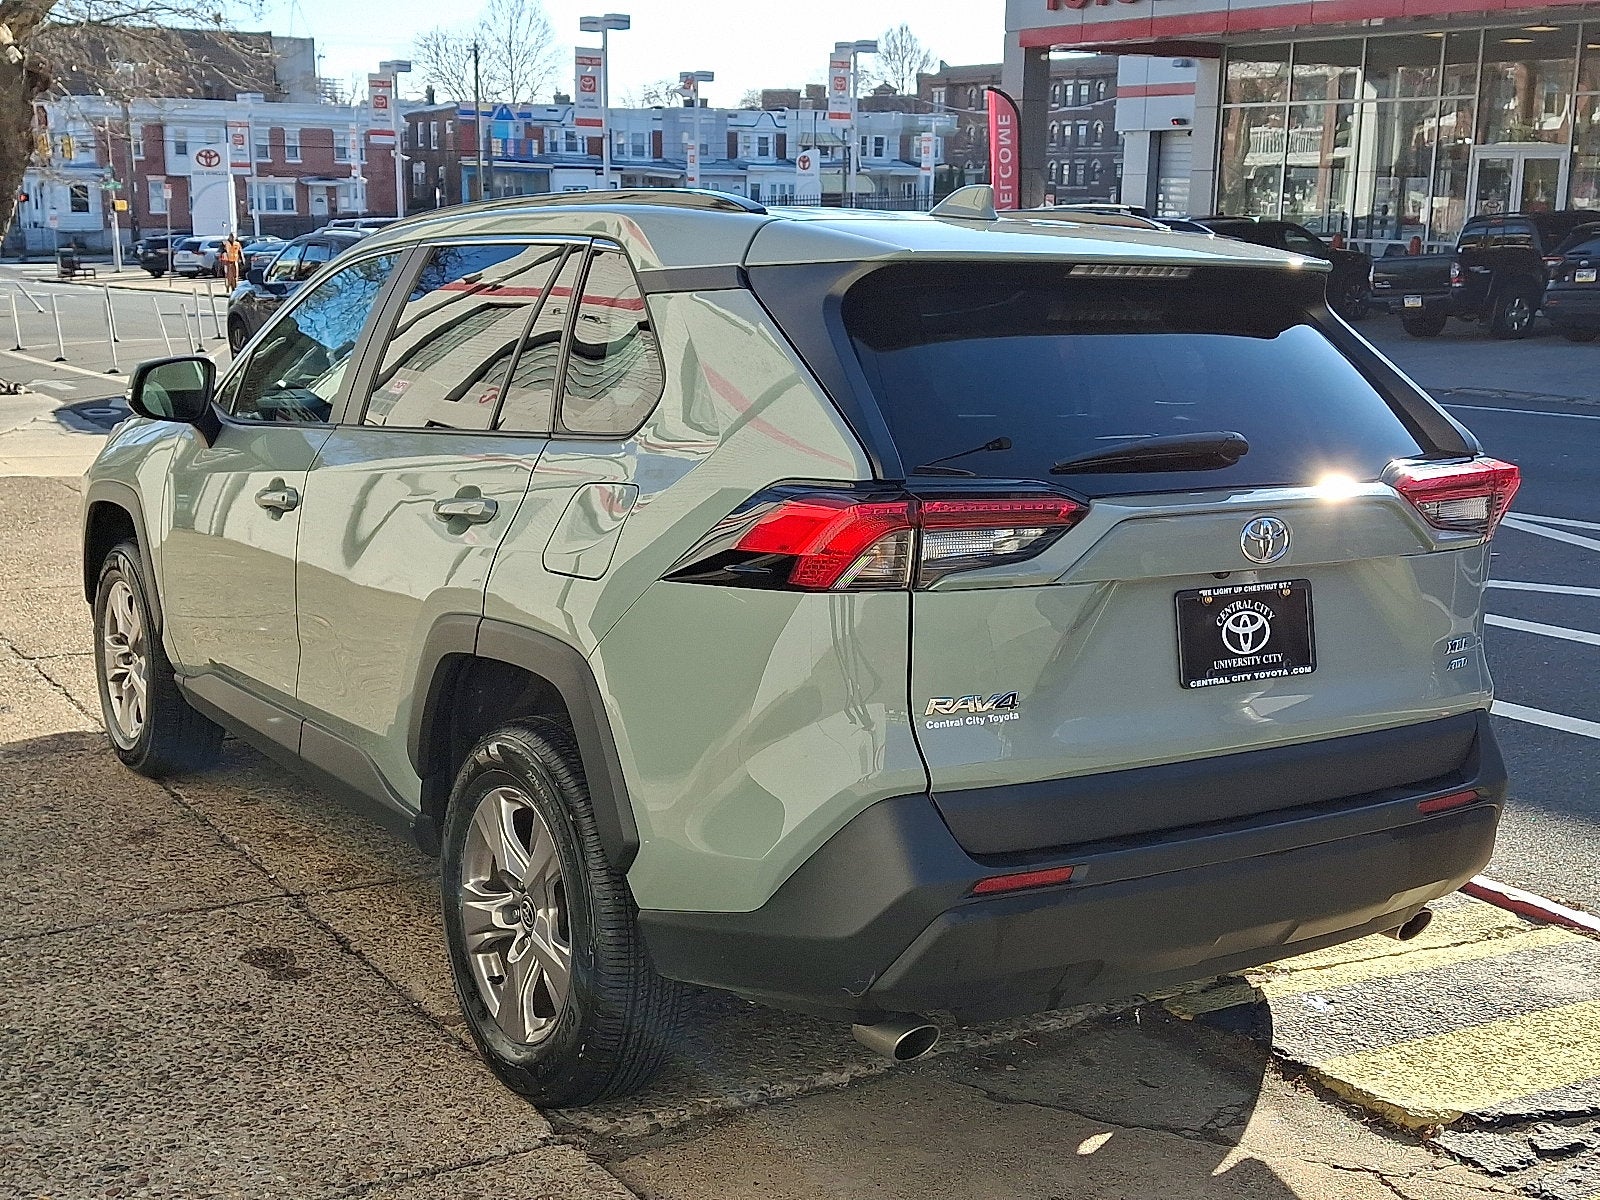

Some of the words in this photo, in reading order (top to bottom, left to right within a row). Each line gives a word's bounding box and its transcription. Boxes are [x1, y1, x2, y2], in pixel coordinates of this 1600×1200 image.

[1213, 587, 1232, 596] LIGHT
[1234, 586, 1243, 594] UP
[1243, 583, 1278, 593] CHESTNUT
[1216, 599, 1254, 627] CENTRAL
[1253, 602, 1276, 620] CITY
[1213, 656, 1261, 670] UNIVERSITY
[1262, 652, 1284, 664] CITY
[1190, 676, 1230, 688] CENTRAL
[1231, 673, 1252, 683] CITY
[1253, 669, 1289, 680] TOYOTA
[1290, 665, 1312, 675] .COM
[924, 691, 1019, 716] RAV4
[925, 717, 964, 730] Central
[965, 715, 986, 726] City
[987, 712, 1020, 723] Toyota
